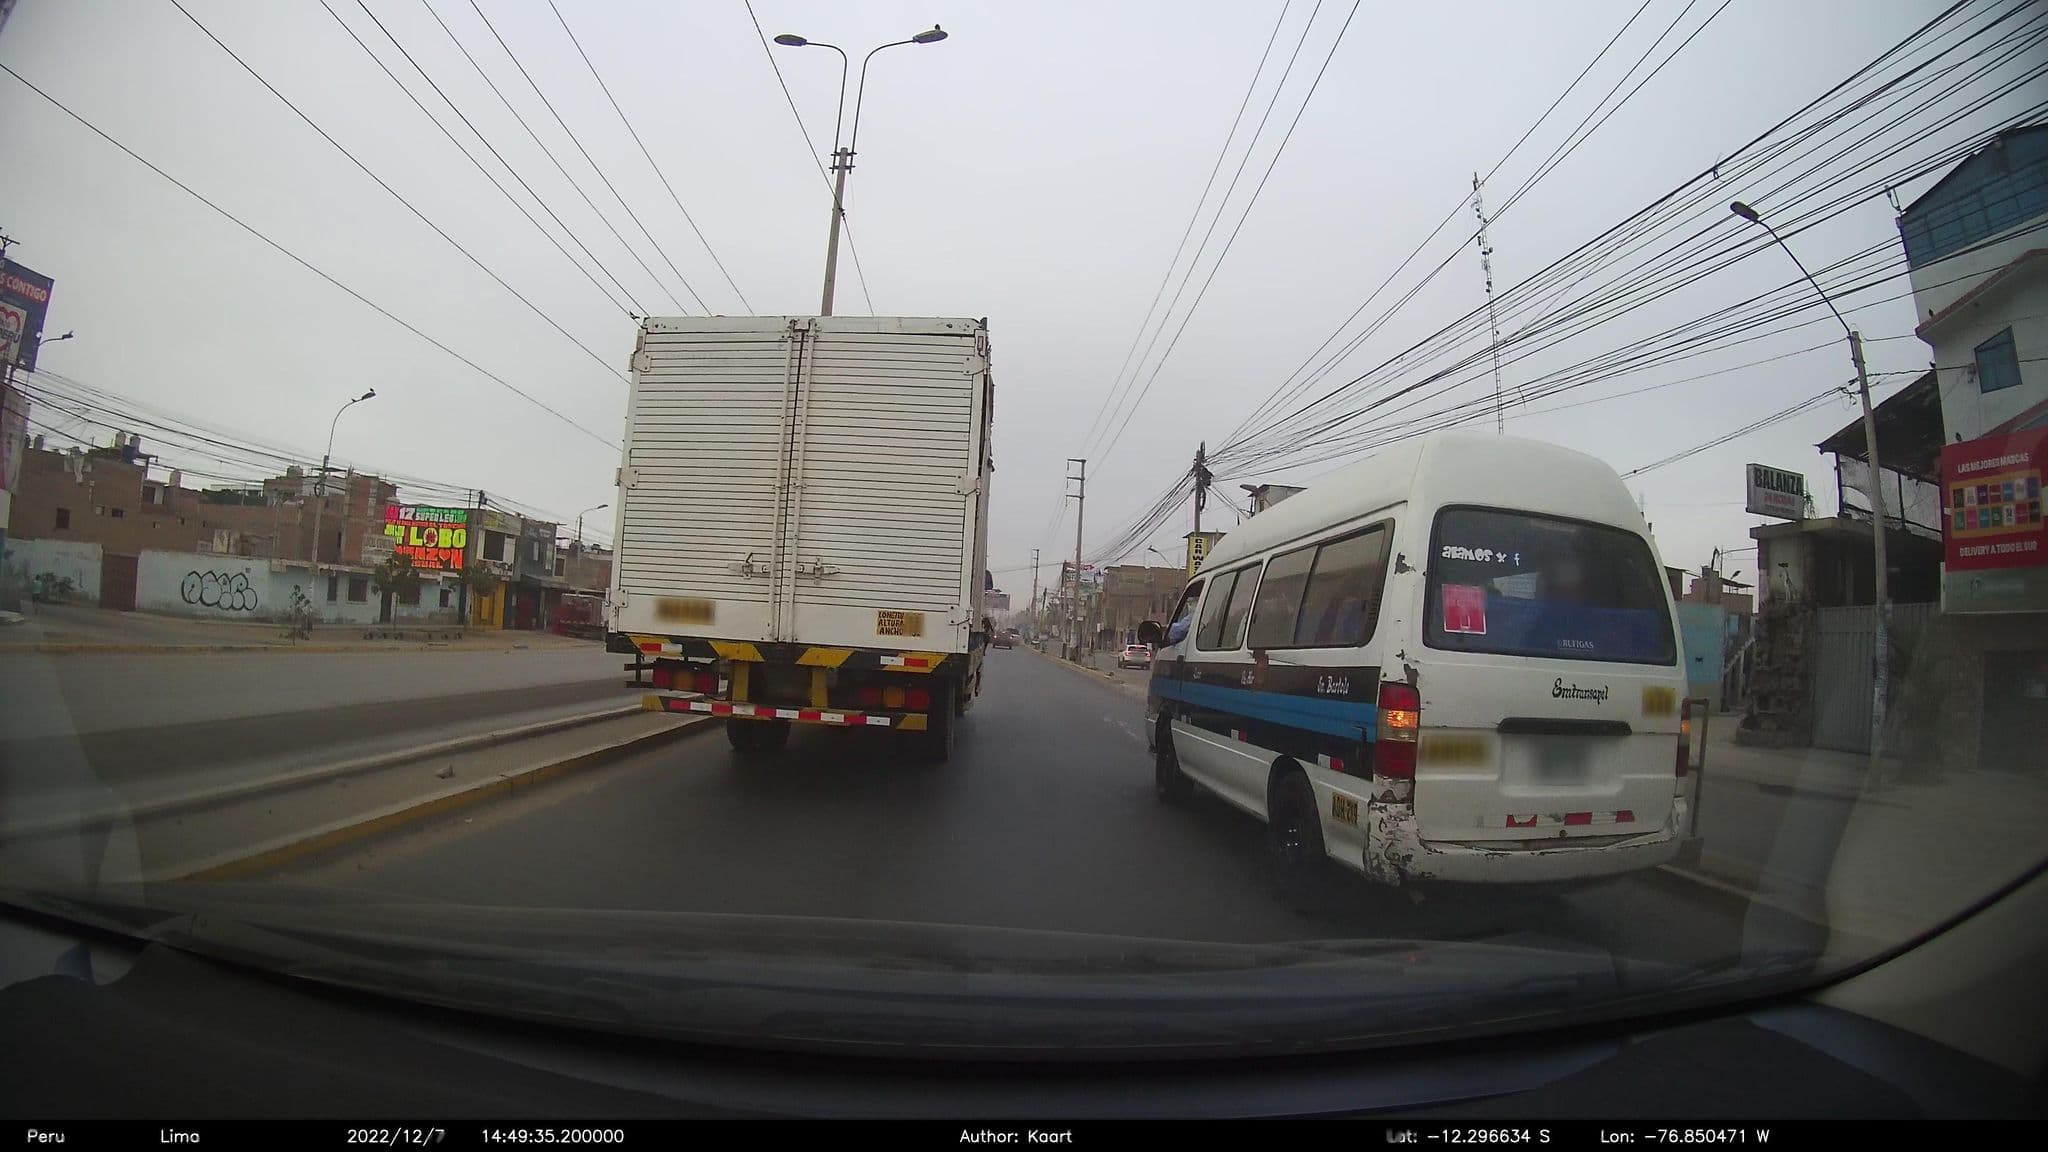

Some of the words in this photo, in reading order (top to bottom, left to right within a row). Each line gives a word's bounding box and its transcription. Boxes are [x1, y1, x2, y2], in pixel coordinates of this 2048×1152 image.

[6, 276, 47, 302] CONTIGO
[2000, 453, 2029, 468] MARCAS
[1753, 467, 1803, 496] BALANZA
[408, 526, 467, 549] LOBO
[1194, 538, 1203, 554] CAR
[1959, 544, 1991, 557] DELIVERY
[1996, 542, 2015, 554] TODO
